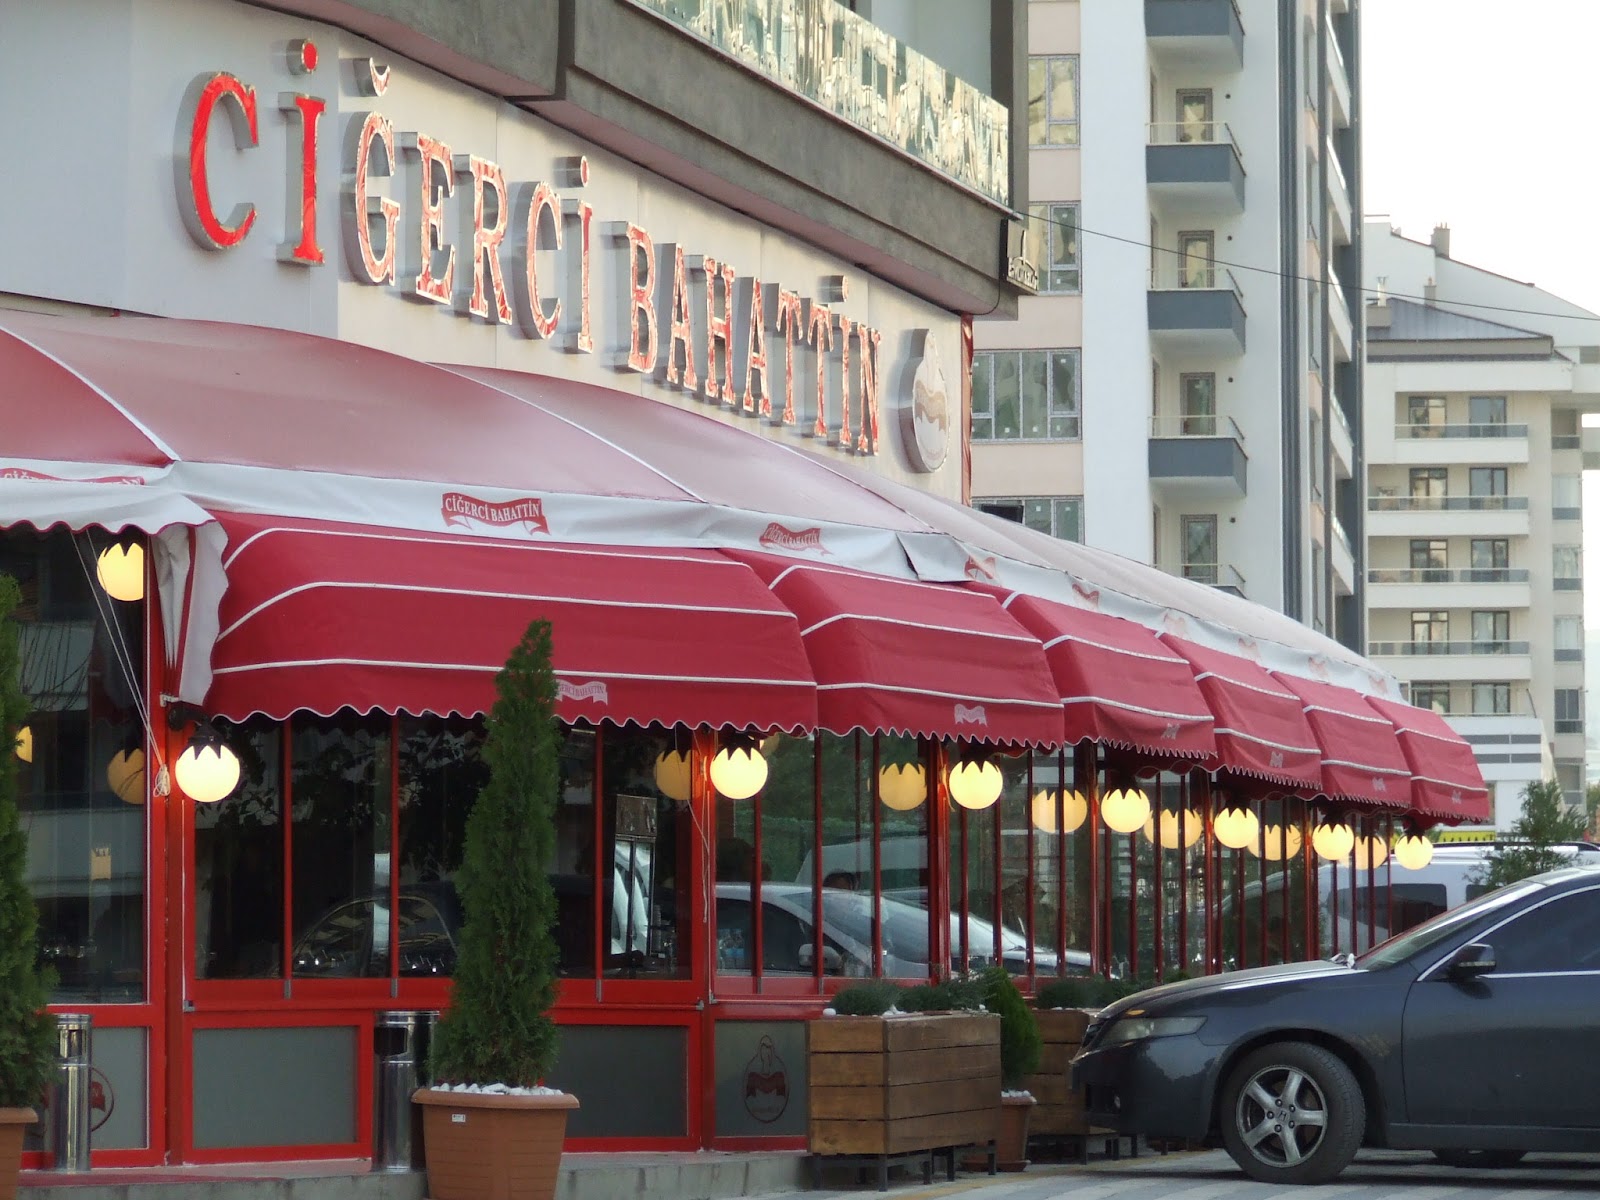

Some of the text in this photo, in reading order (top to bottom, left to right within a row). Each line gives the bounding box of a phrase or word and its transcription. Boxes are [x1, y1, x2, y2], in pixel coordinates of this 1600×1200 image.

[180, 38, 881, 456] CİĞERCİ BAHATTİN
[445, 495, 540, 522] CİĞERCİ BAHATTİN
